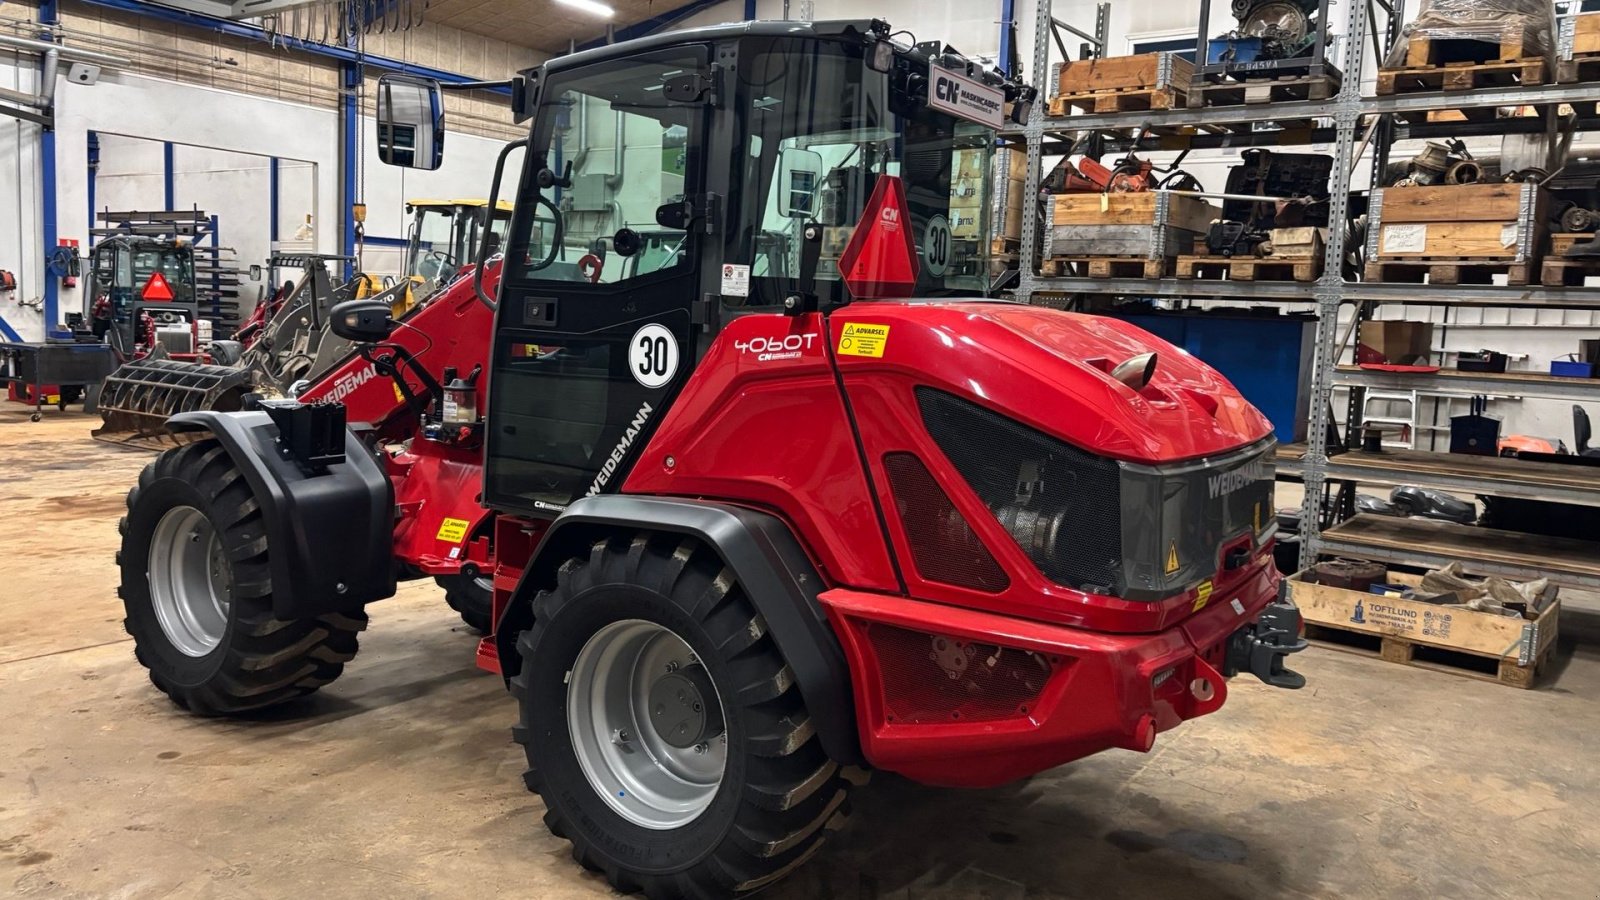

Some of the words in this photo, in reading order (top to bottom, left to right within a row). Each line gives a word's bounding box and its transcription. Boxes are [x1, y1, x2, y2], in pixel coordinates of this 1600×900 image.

[936, 76, 959, 104] CN
[882, 207, 898, 221] CN
[929, 226, 948, 265] 30
[855, 327, 885, 336] ADVARSEL
[638, 335, 669, 376] 30
[758, 352, 772, 361] CN
[585, 401, 653, 497] WEIDEMANN
[534, 500, 546, 509] CN
[1369, 603, 1418, 618] TOFTLUND
